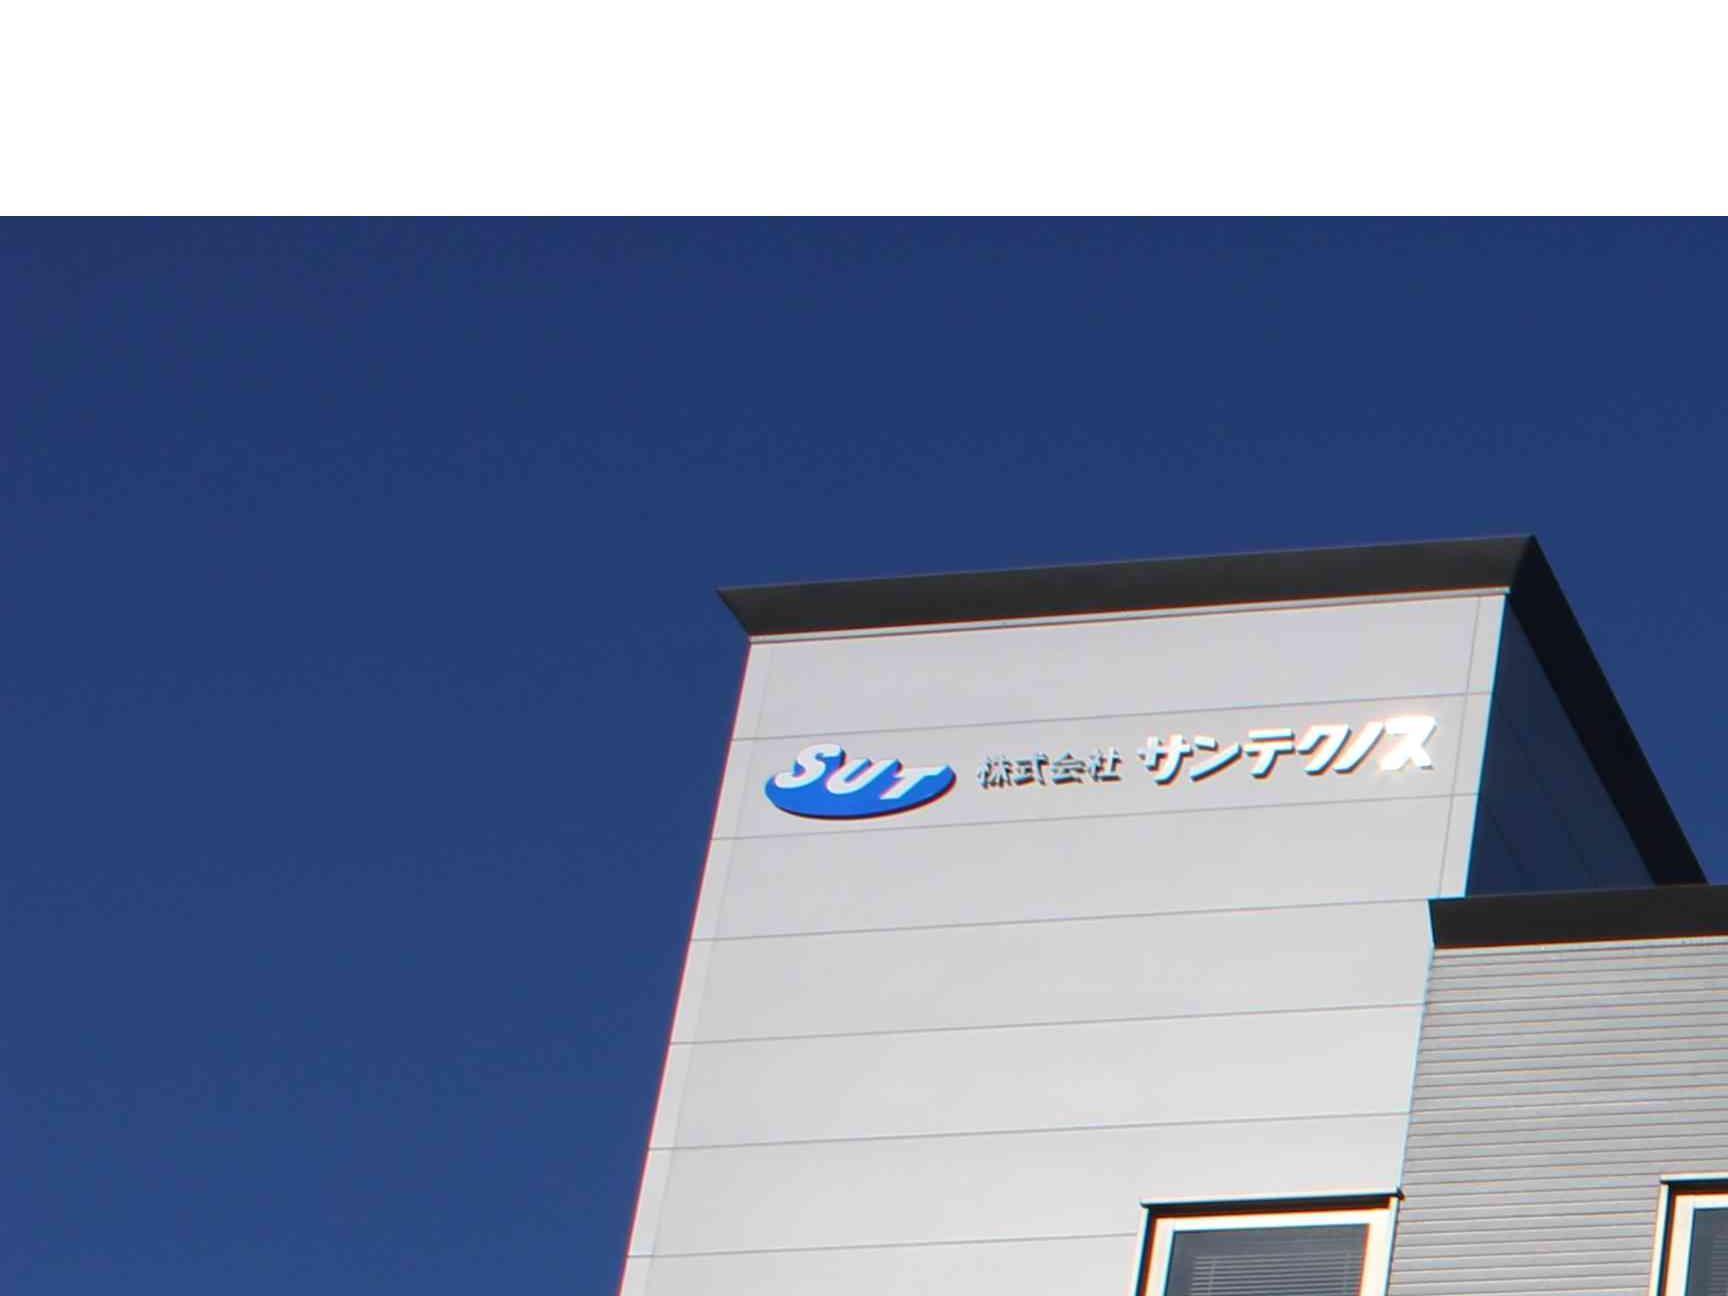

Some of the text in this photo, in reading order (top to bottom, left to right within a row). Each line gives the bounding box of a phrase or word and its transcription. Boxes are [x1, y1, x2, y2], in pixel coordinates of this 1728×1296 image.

[774, 743, 947, 801] SUT
[977, 714, 1438, 788] 株式会社 サンテクノス
